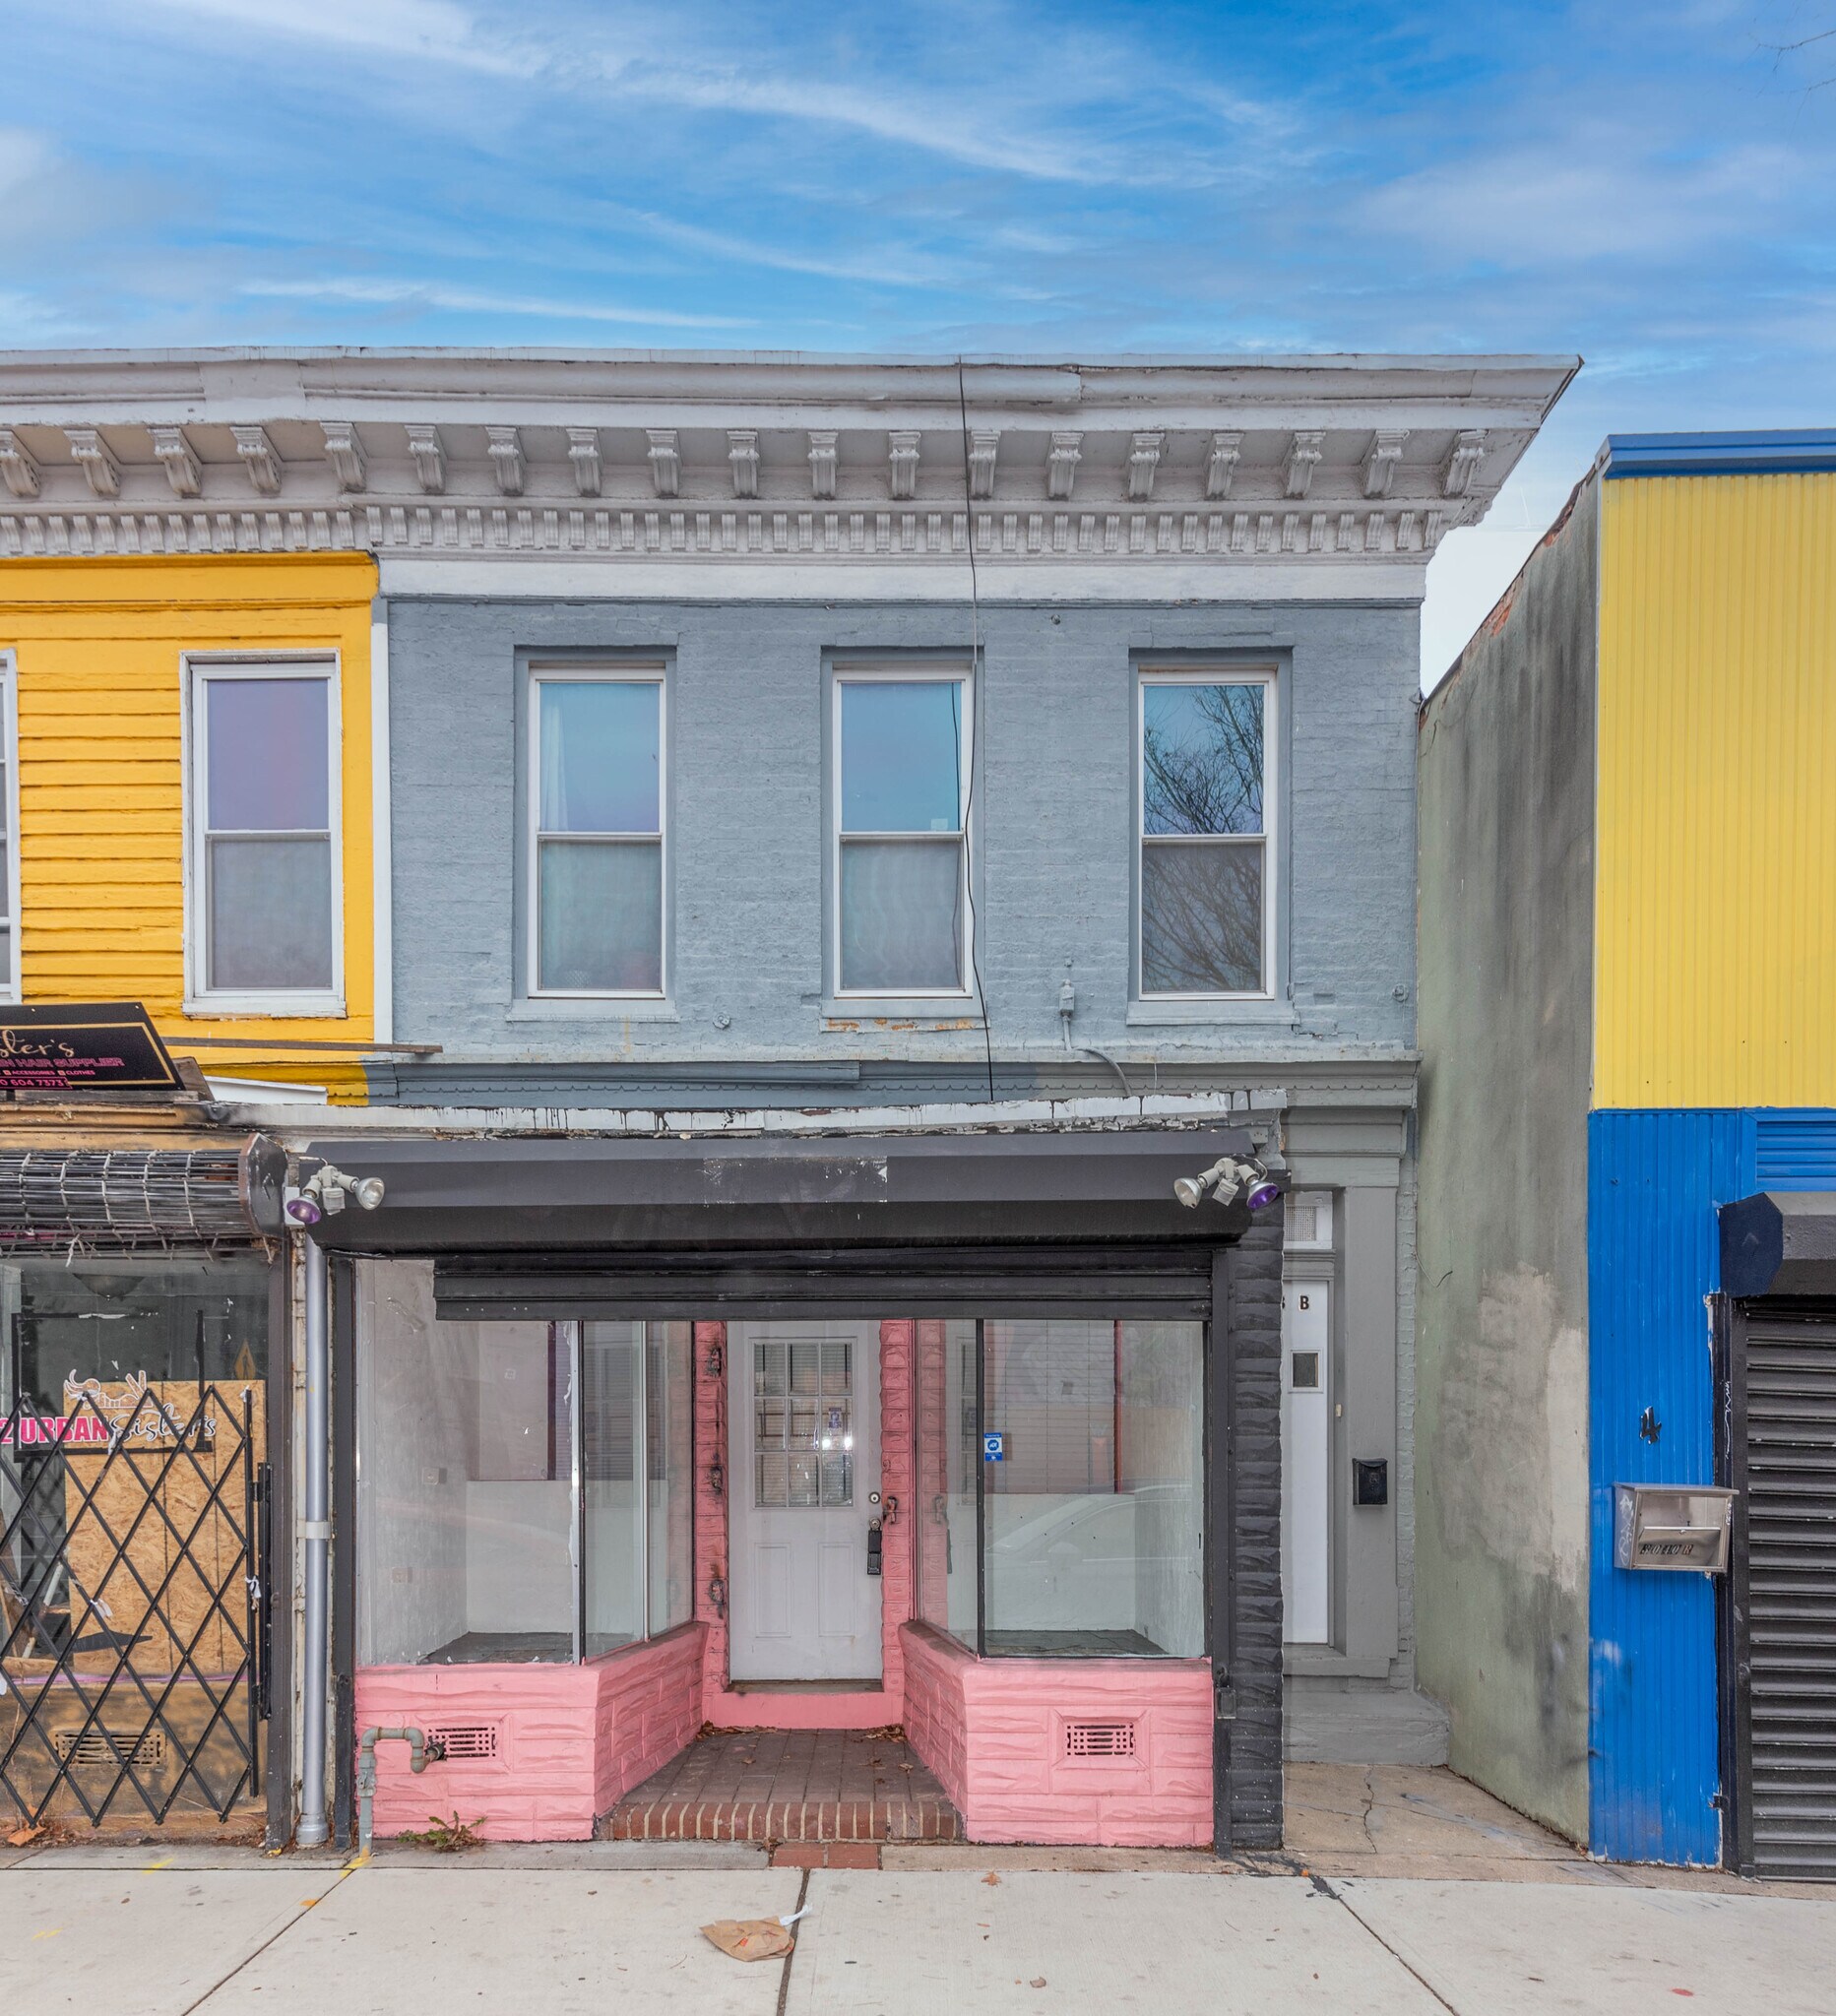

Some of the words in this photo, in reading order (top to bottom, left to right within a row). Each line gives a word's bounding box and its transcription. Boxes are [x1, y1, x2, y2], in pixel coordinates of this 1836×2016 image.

[15, 1058, 53, 1067] HAIR
[53, 1057, 125, 1067] SUPPLIER
[1299, 1294, 1309, 1310] B
[20, 1417, 109, 1443] URBAN
